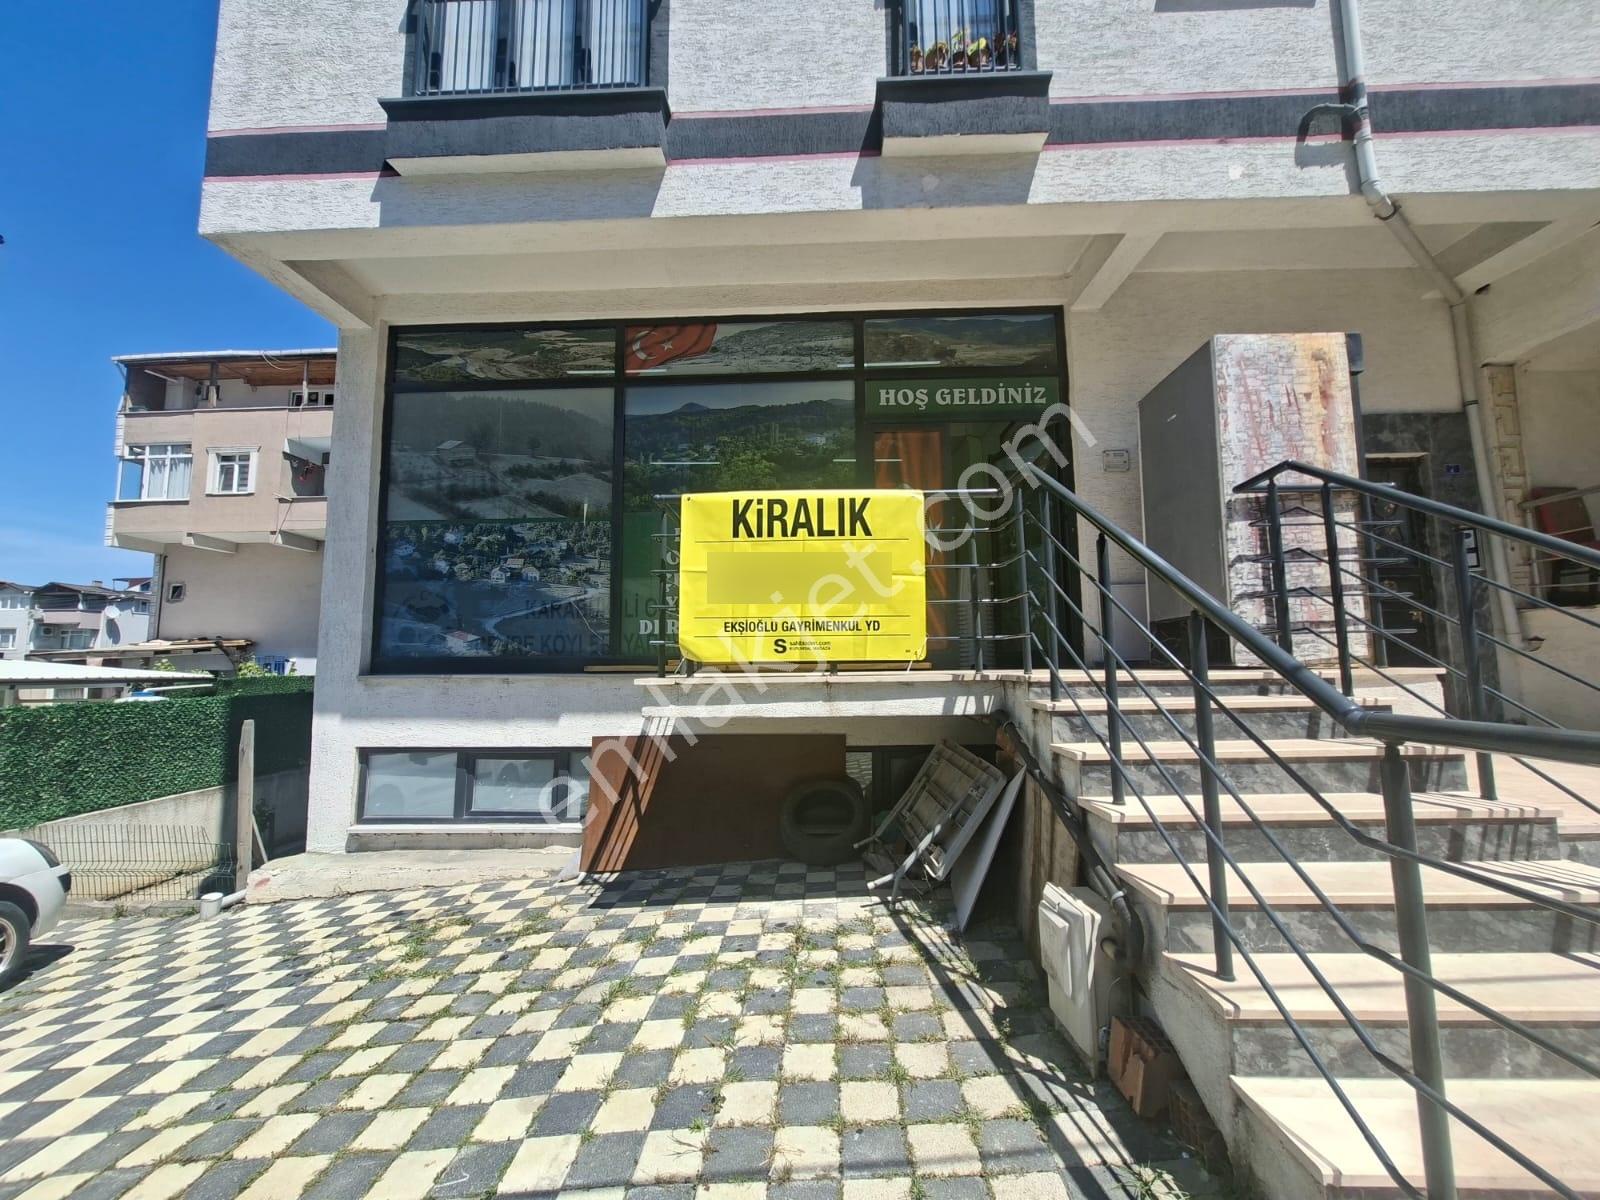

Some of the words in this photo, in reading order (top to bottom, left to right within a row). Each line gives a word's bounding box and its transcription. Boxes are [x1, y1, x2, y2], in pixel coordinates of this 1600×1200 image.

[879, 388, 929, 410] HOŞ
[935, 382, 1047, 406] GELDİNİZ
[724, 620, 778, 635] EKŞİOĞLU
[782, 619, 862, 633] GAYRİMENKUL
[865, 620, 881, 632] YD
